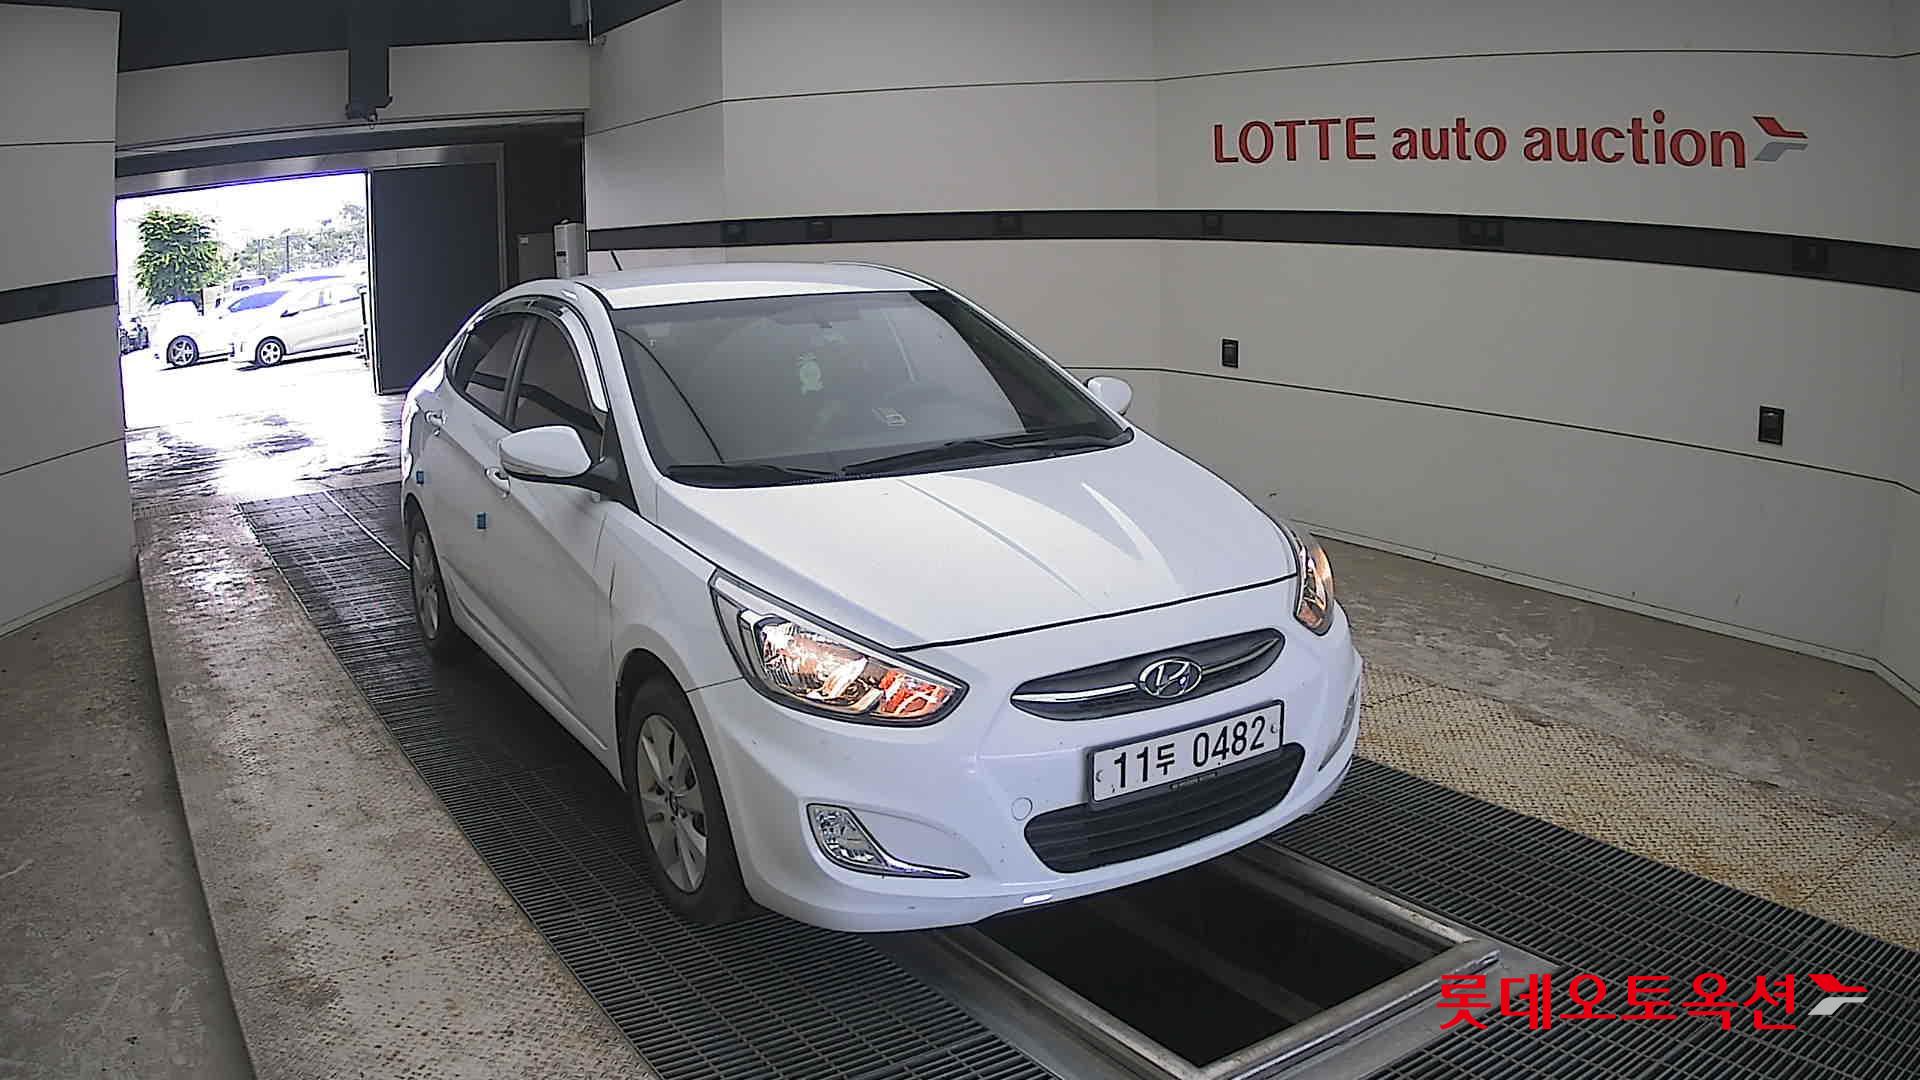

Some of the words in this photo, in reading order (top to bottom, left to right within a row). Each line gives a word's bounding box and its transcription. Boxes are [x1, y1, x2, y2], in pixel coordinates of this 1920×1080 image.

[1213, 116, 1376, 164] LOTTE
[1392, 117, 1507, 162] auto
[1523, 109, 1746, 169] auction
[1113, 742, 1175, 788] 11두
[1192, 715, 1265, 767] 0482
